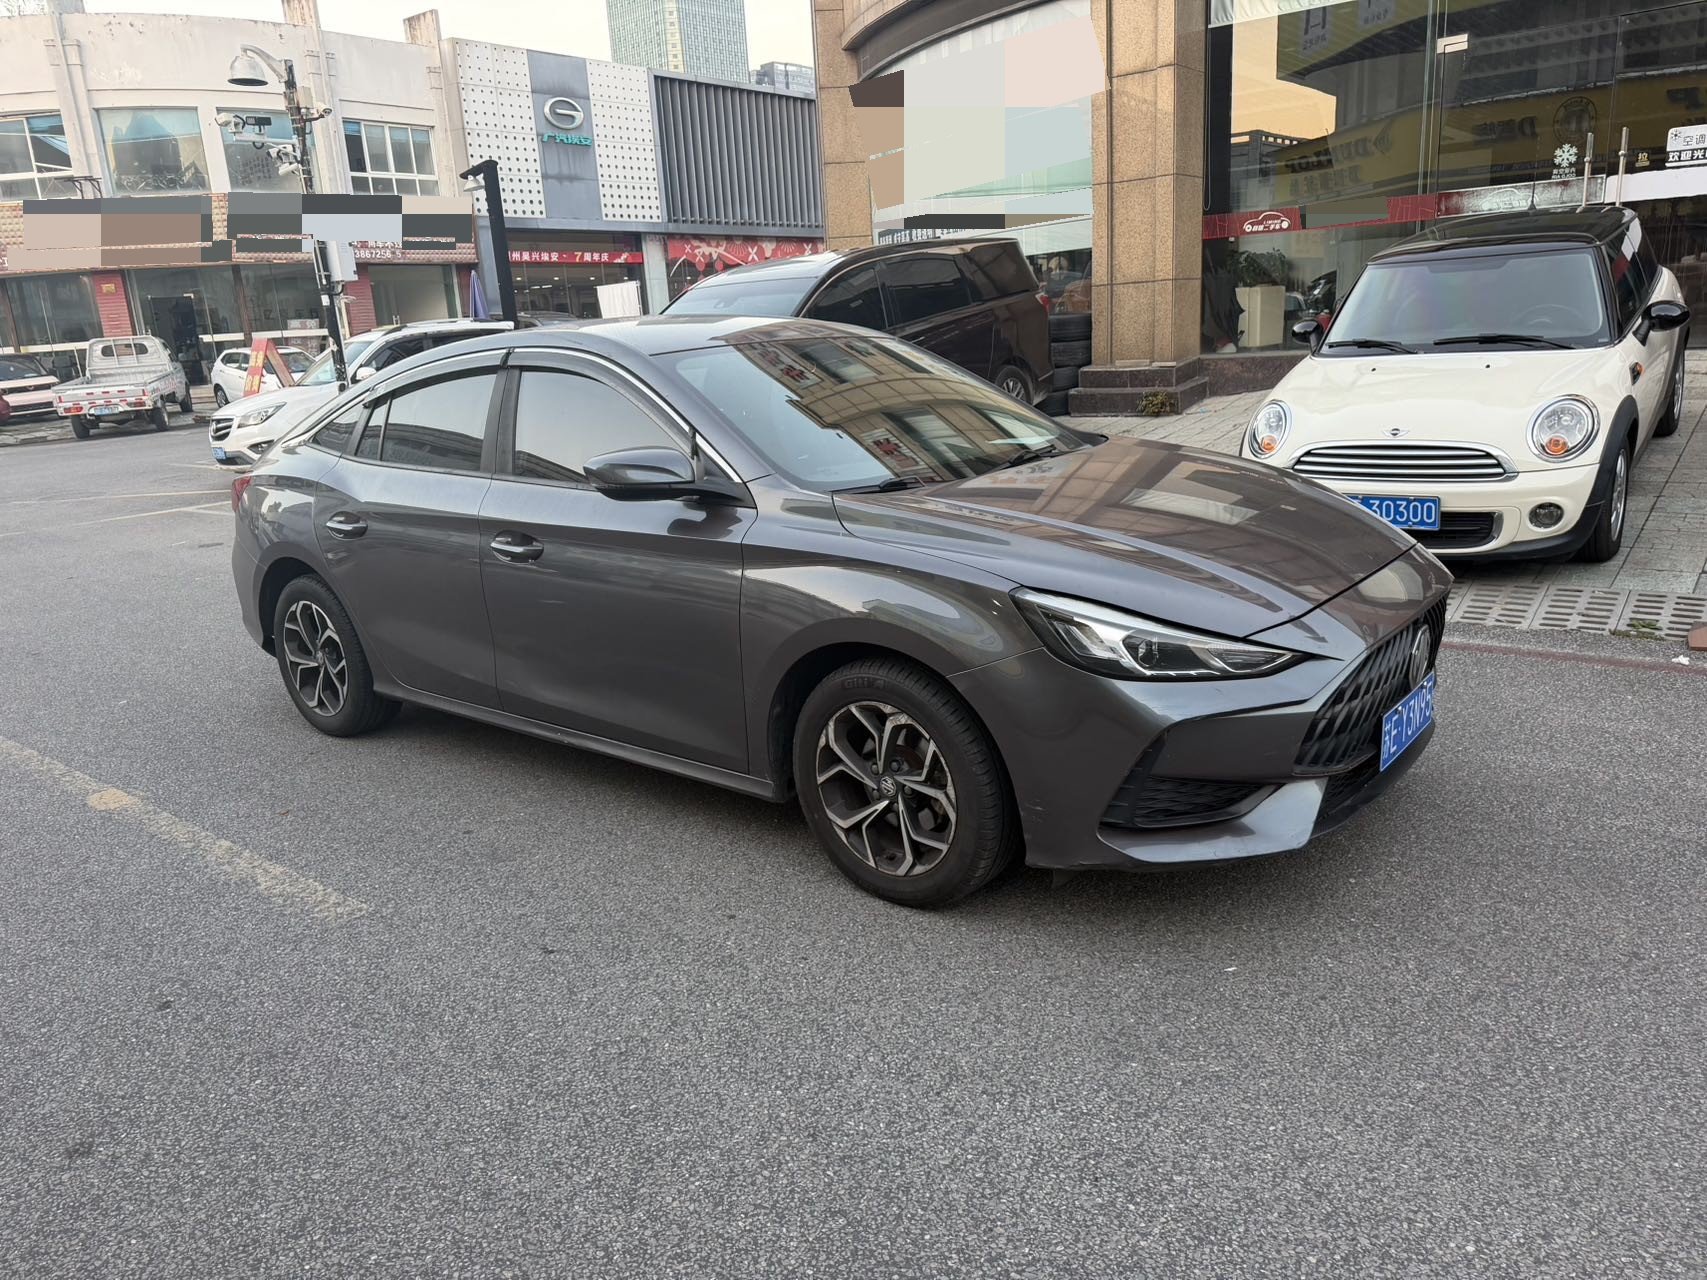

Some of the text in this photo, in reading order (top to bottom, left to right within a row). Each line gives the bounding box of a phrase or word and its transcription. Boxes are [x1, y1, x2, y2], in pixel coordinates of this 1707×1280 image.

[1682, 133, 1706, 146] 空调
[1637, 152, 1649, 162] 拉
[1667, 149, 1707, 162] 欢迎光
[1354, 499, 1436, 523] 30300
